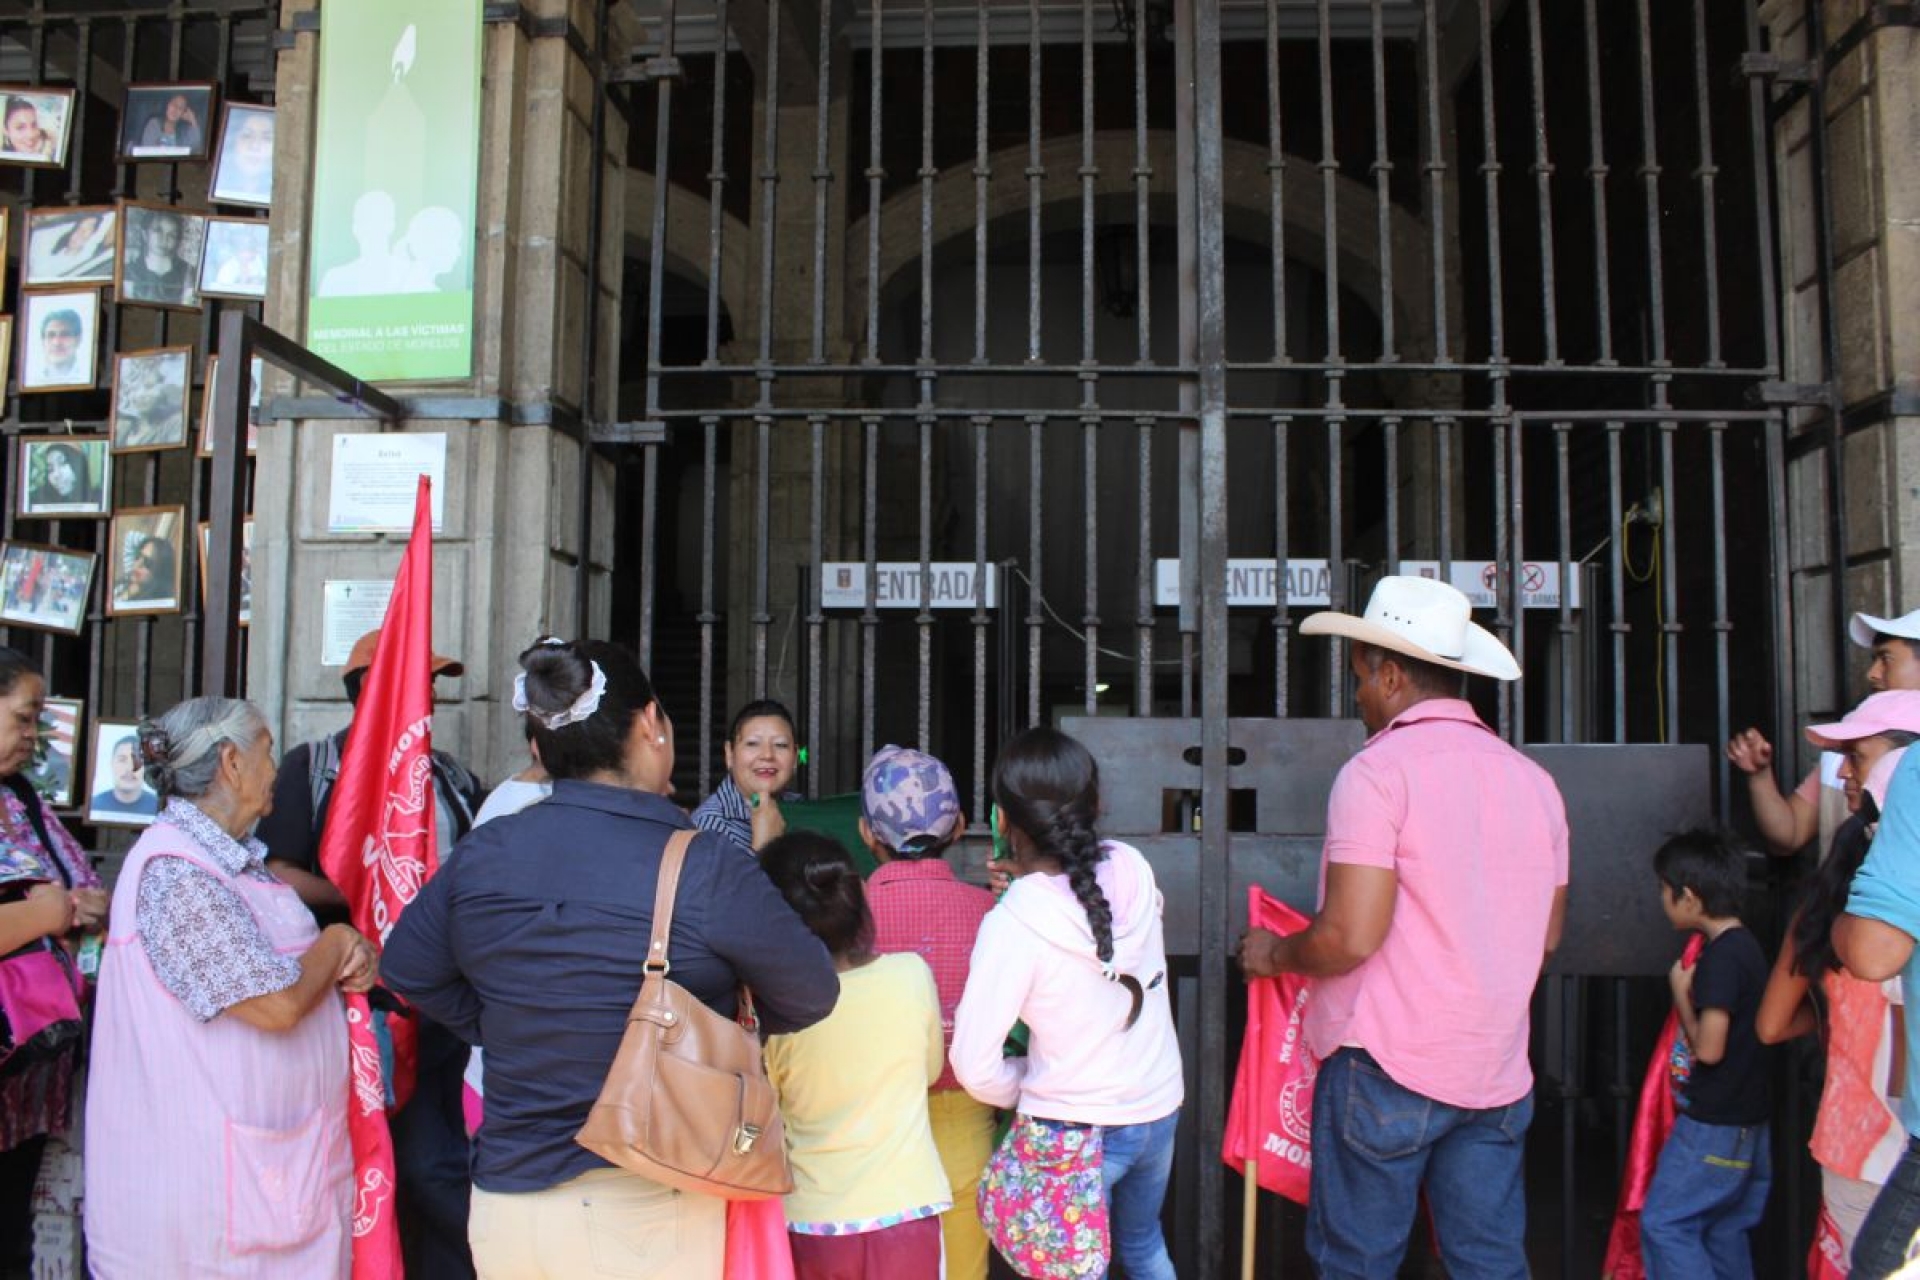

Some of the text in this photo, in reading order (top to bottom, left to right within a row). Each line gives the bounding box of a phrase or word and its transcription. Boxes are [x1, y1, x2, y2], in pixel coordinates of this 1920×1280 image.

[313, 327, 372, 340] MEMORIAL
[375, 327, 383, 337] A
[385, 325, 409, 337] LAS
